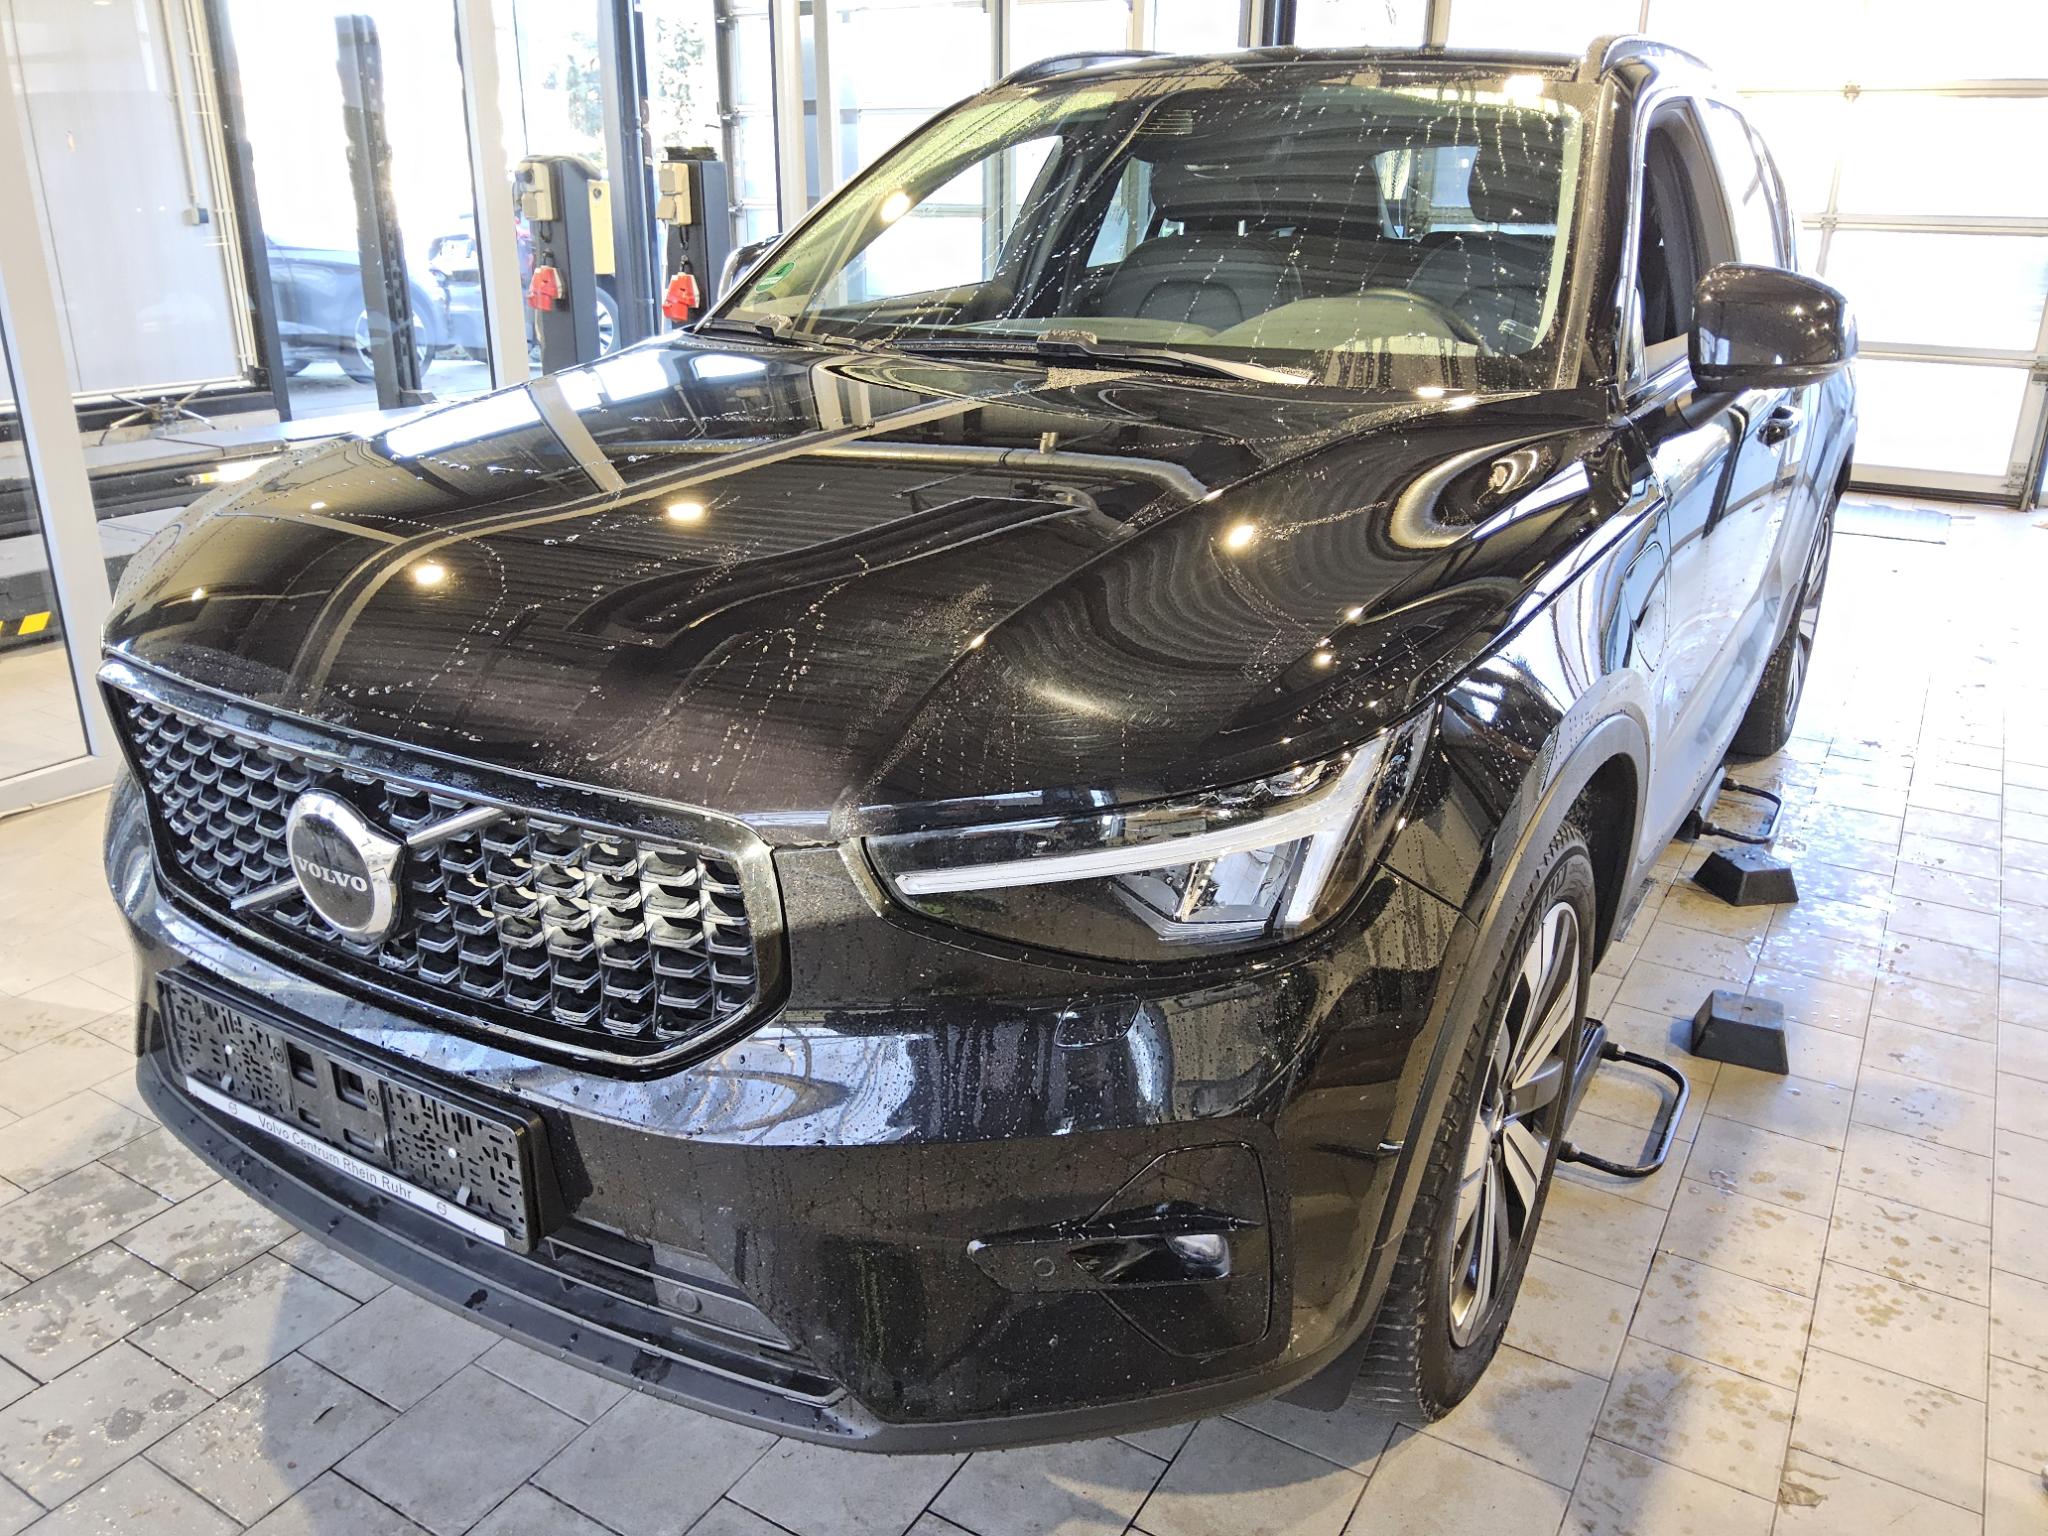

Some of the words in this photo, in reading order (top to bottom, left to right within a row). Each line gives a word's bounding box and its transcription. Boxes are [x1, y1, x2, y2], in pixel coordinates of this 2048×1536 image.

[294, 855, 368, 892] VOLVO
[258, 1114, 289, 1139] Volvo
[292, 1132, 339, 1166] Centrum
[342, 1157, 377, 1184] Rhein
[381, 1175, 412, 1200] Ruhr
